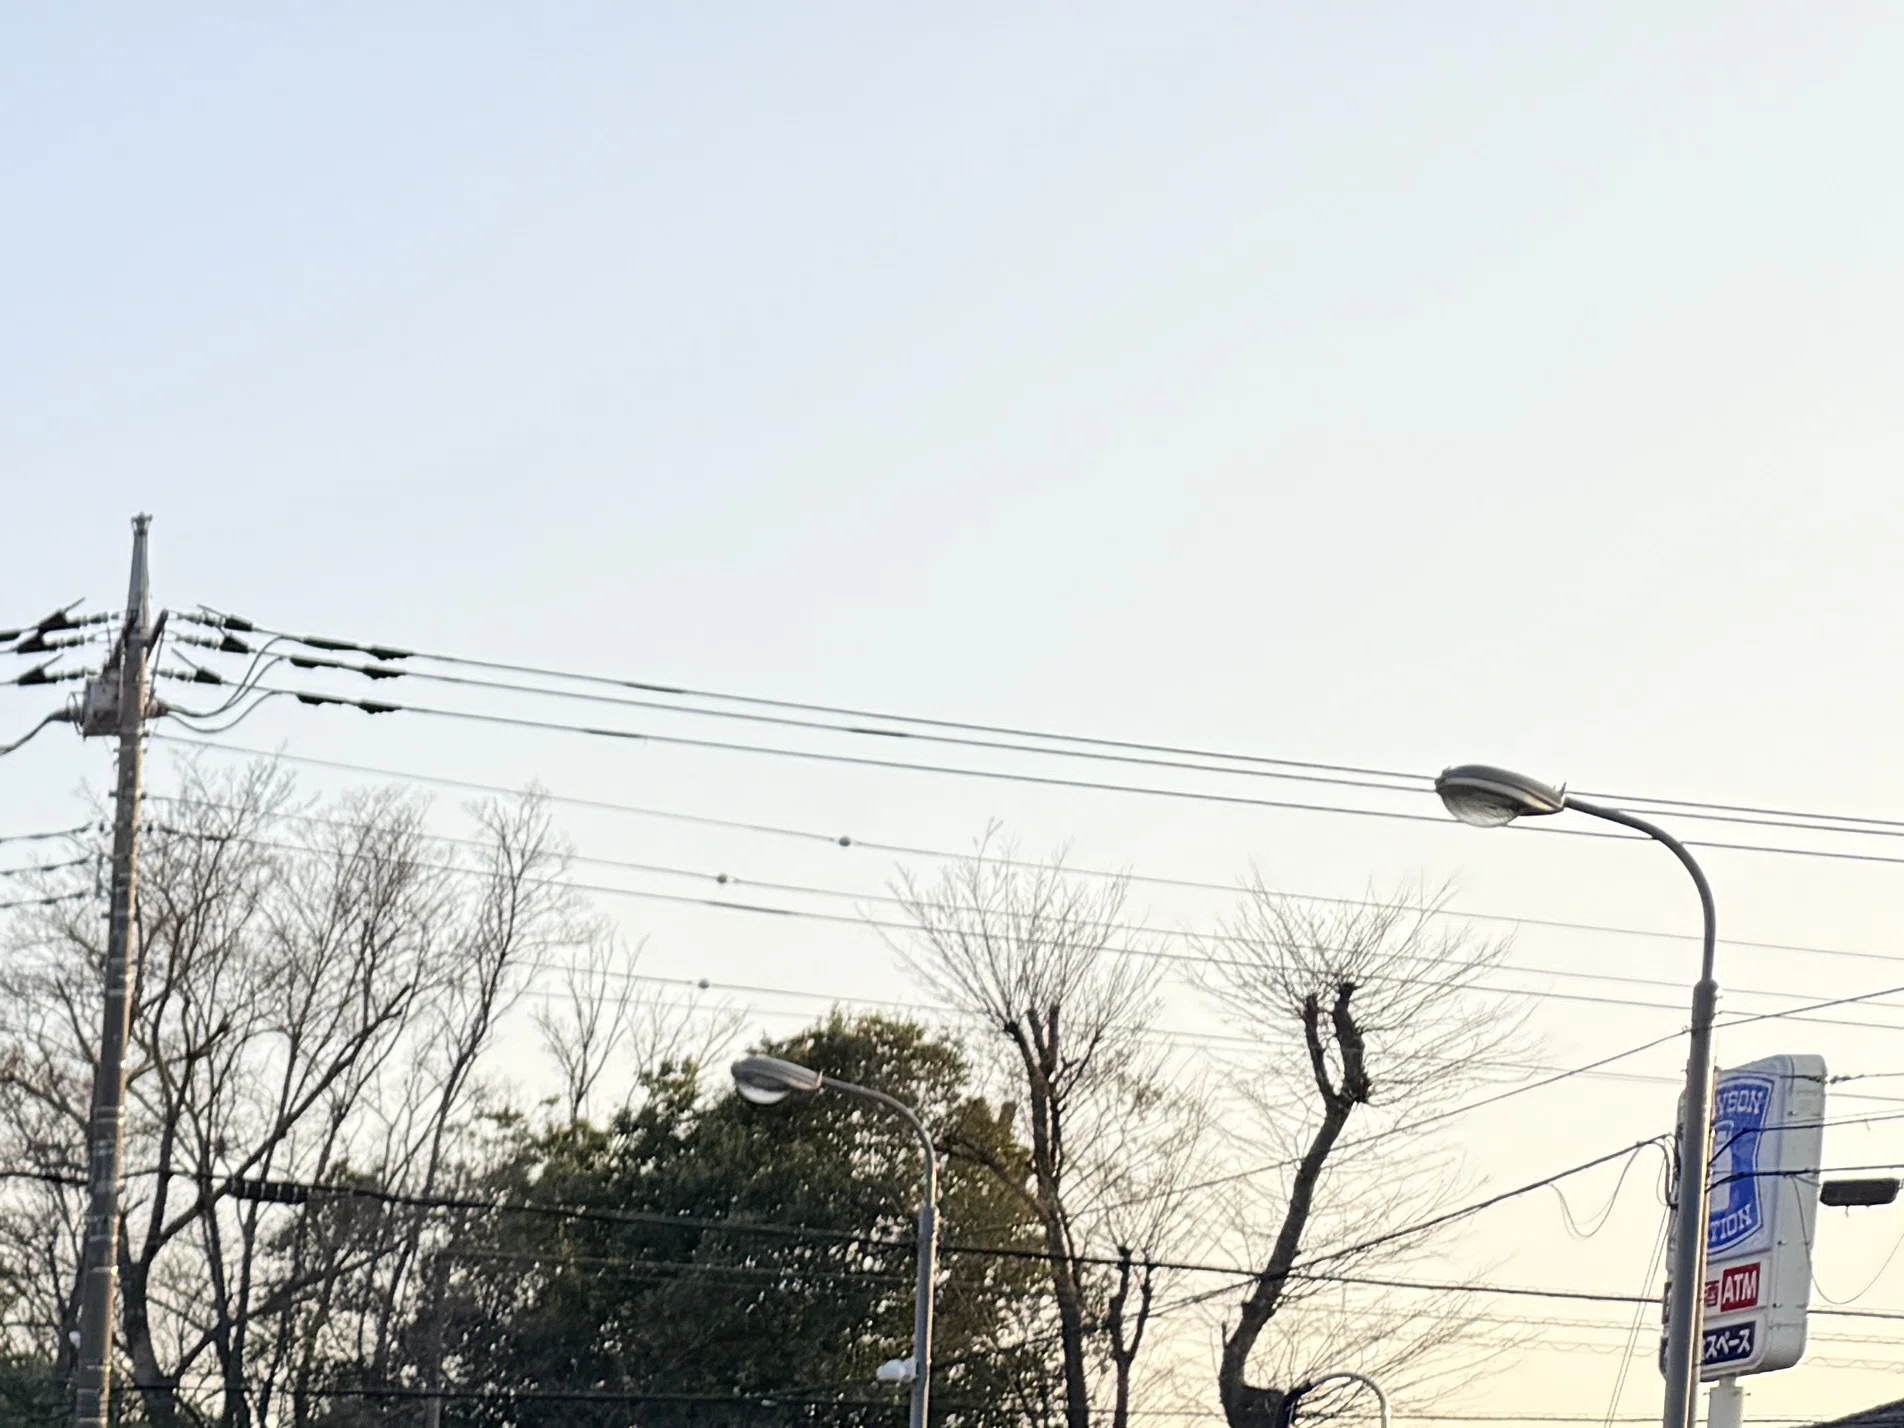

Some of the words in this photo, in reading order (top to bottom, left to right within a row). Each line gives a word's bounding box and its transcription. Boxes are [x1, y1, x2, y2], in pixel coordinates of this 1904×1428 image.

[1710, 1203, 1752, 1242] TION
[1723, 1270, 1757, 1304] ATM
[1704, 1328, 1750, 1359] スペース
